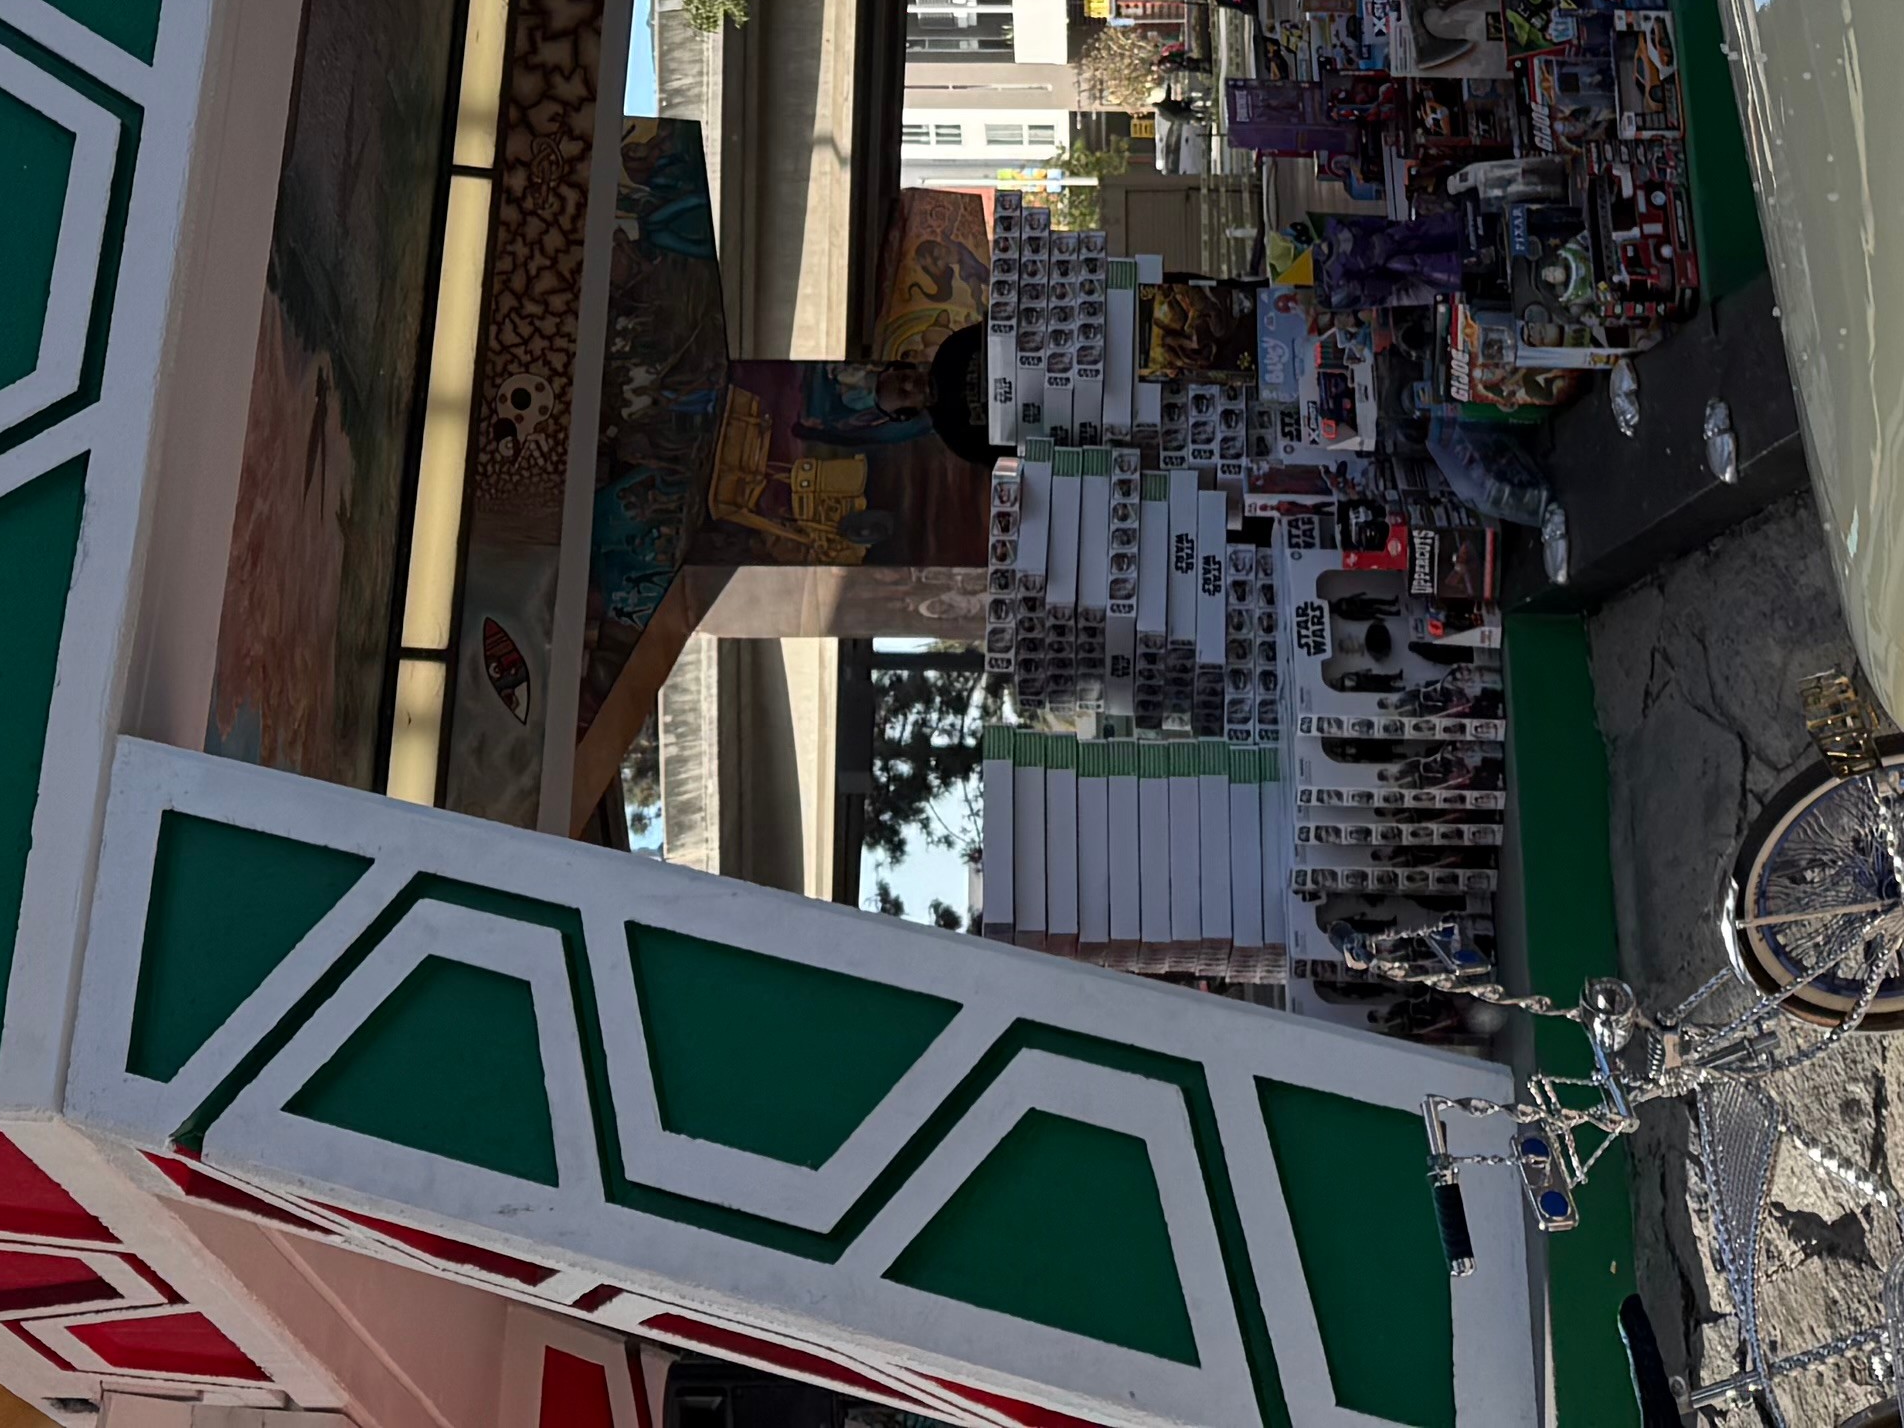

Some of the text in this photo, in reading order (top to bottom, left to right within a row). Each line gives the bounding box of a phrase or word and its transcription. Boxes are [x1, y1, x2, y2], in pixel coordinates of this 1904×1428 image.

[1513, 206, 1525, 251] PIXAR
[1410, 529, 1434, 595] UPPERCUTS
[1296, 601, 1311, 656] STAR
[1310, 601, 1327, 656] WARS
